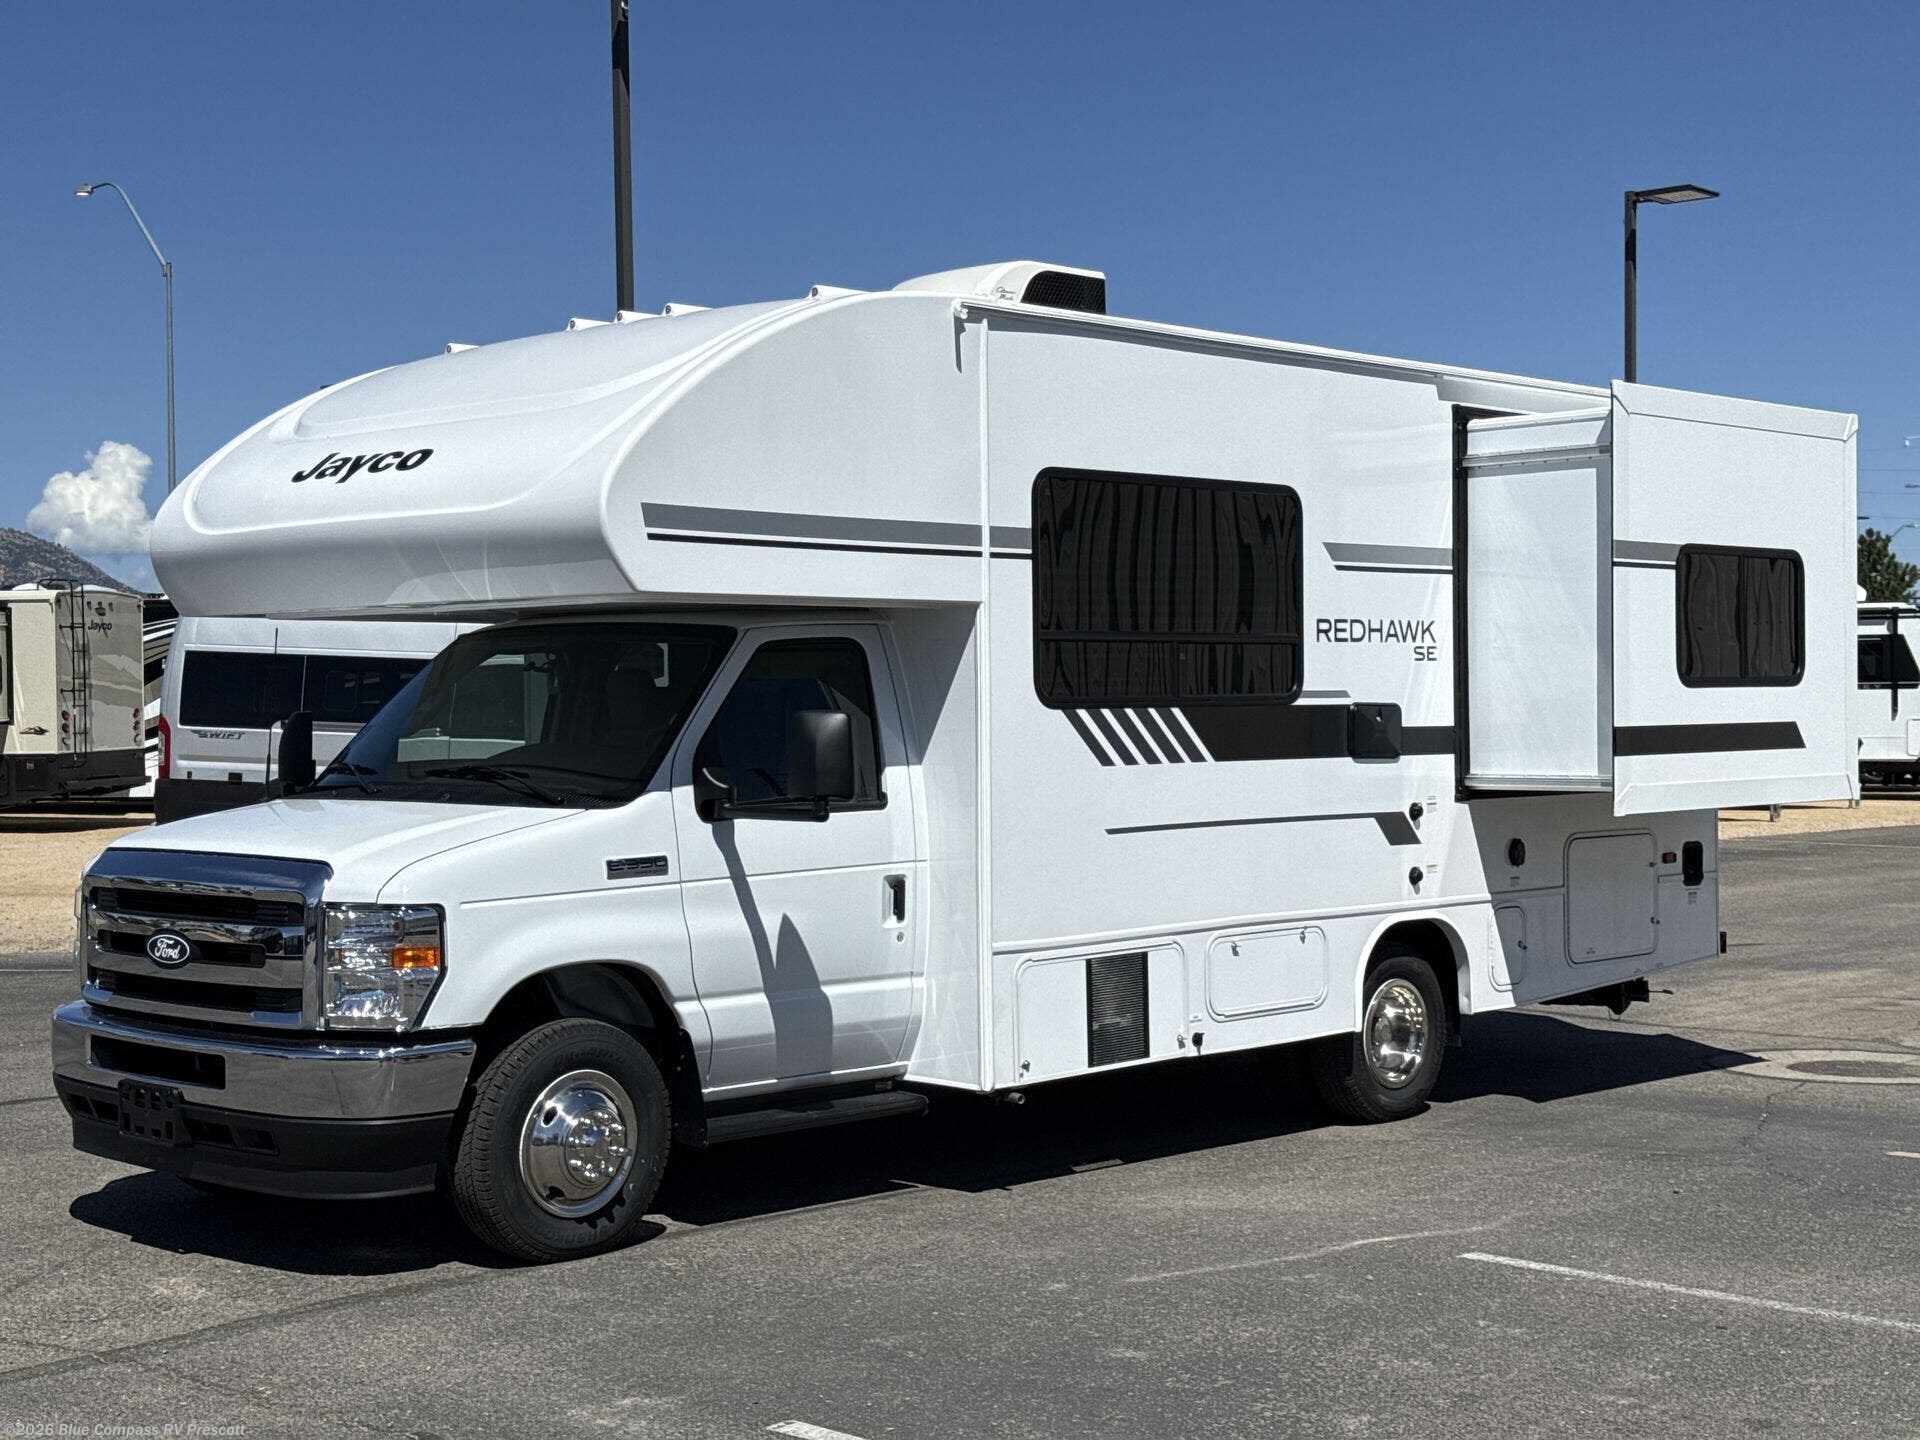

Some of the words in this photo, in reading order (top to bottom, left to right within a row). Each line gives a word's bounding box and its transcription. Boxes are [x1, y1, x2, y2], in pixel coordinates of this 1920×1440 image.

[291, 448, 434, 484] Jayco
[87, 619, 113, 632] Jayco
[1316, 618, 1437, 643] REDHAWK
[1413, 645, 1437, 661] SE
[154, 937, 181, 959] Ford
